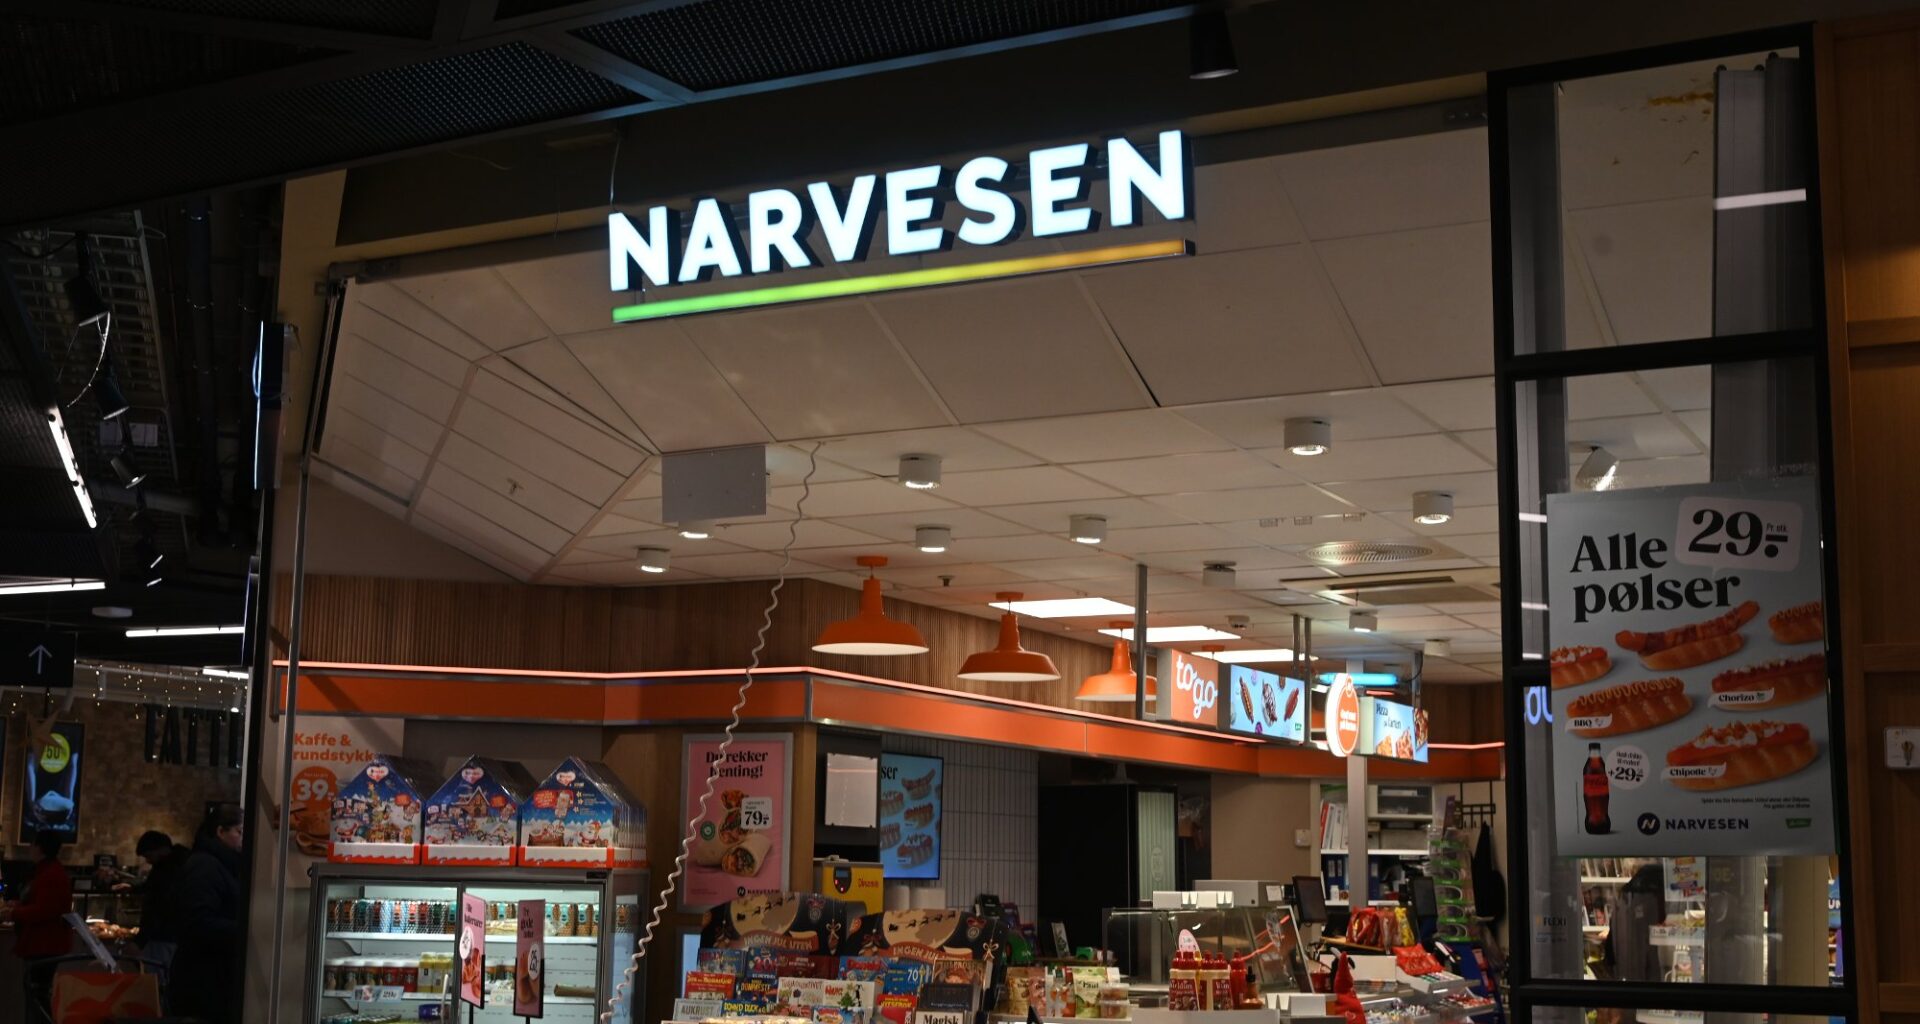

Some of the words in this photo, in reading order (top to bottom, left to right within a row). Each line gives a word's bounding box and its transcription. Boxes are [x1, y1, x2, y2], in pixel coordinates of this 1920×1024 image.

[608, 129, 1185, 292] NARVESEN
[1570, 532, 1668, 573] Alle
[1572, 573, 1741, 623] pølser
[1718, 693, 1755, 702] Chorizo
[1574, 719, 1592, 728] BBQ
[294, 733, 338, 746] Kaffe
[340, 734, 352, 746] &
[292, 749, 374, 764] rundstykk
[726, 751, 769, 763] rekker
[881, 766, 898, 780] ser
[1669, 768, 1706, 777] Chipotle
[1665, 818, 1749, 831] NARVESEN
[893, 946, 923, 958] INGEN
[908, 968, 919, 983] 70
